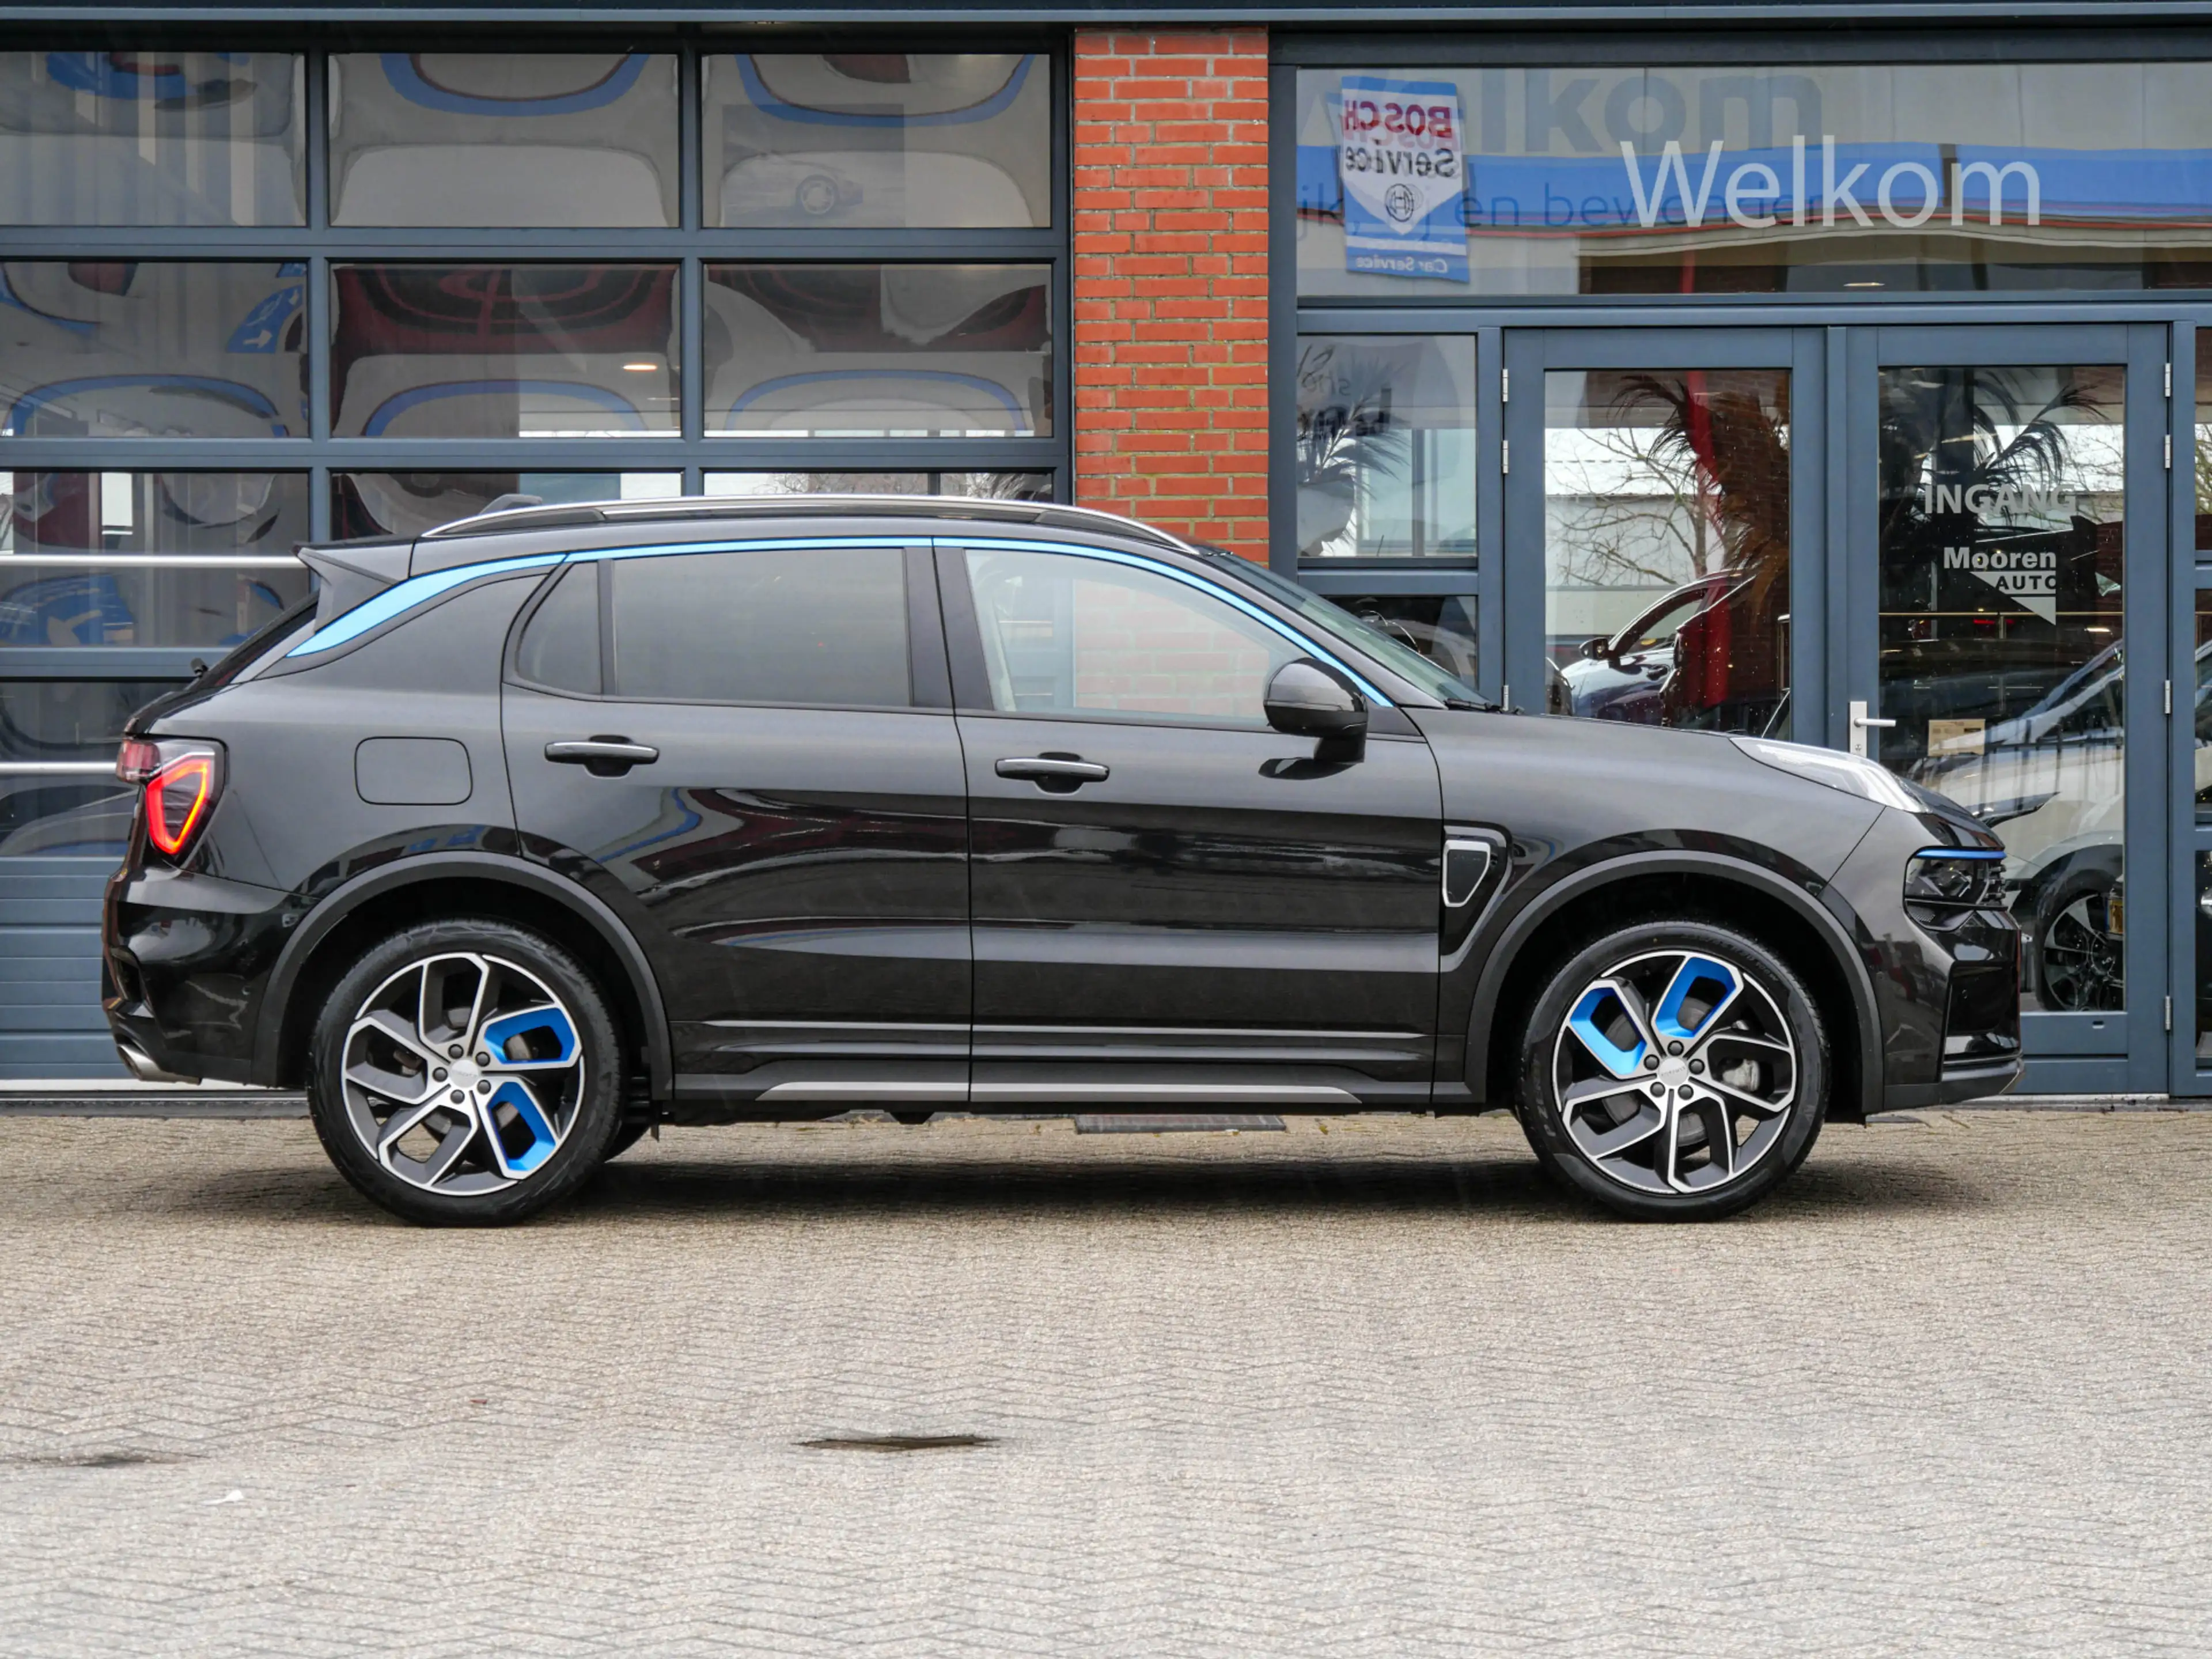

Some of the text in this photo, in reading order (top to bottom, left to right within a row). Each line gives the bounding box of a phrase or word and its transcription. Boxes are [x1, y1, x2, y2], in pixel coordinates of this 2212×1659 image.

[1620, 135, 2040, 228] Welkom
[1925, 483, 2076, 514] INGANG
[1944, 547, 2056, 569] Mooren
[1997, 575, 2057, 590] AUTO
